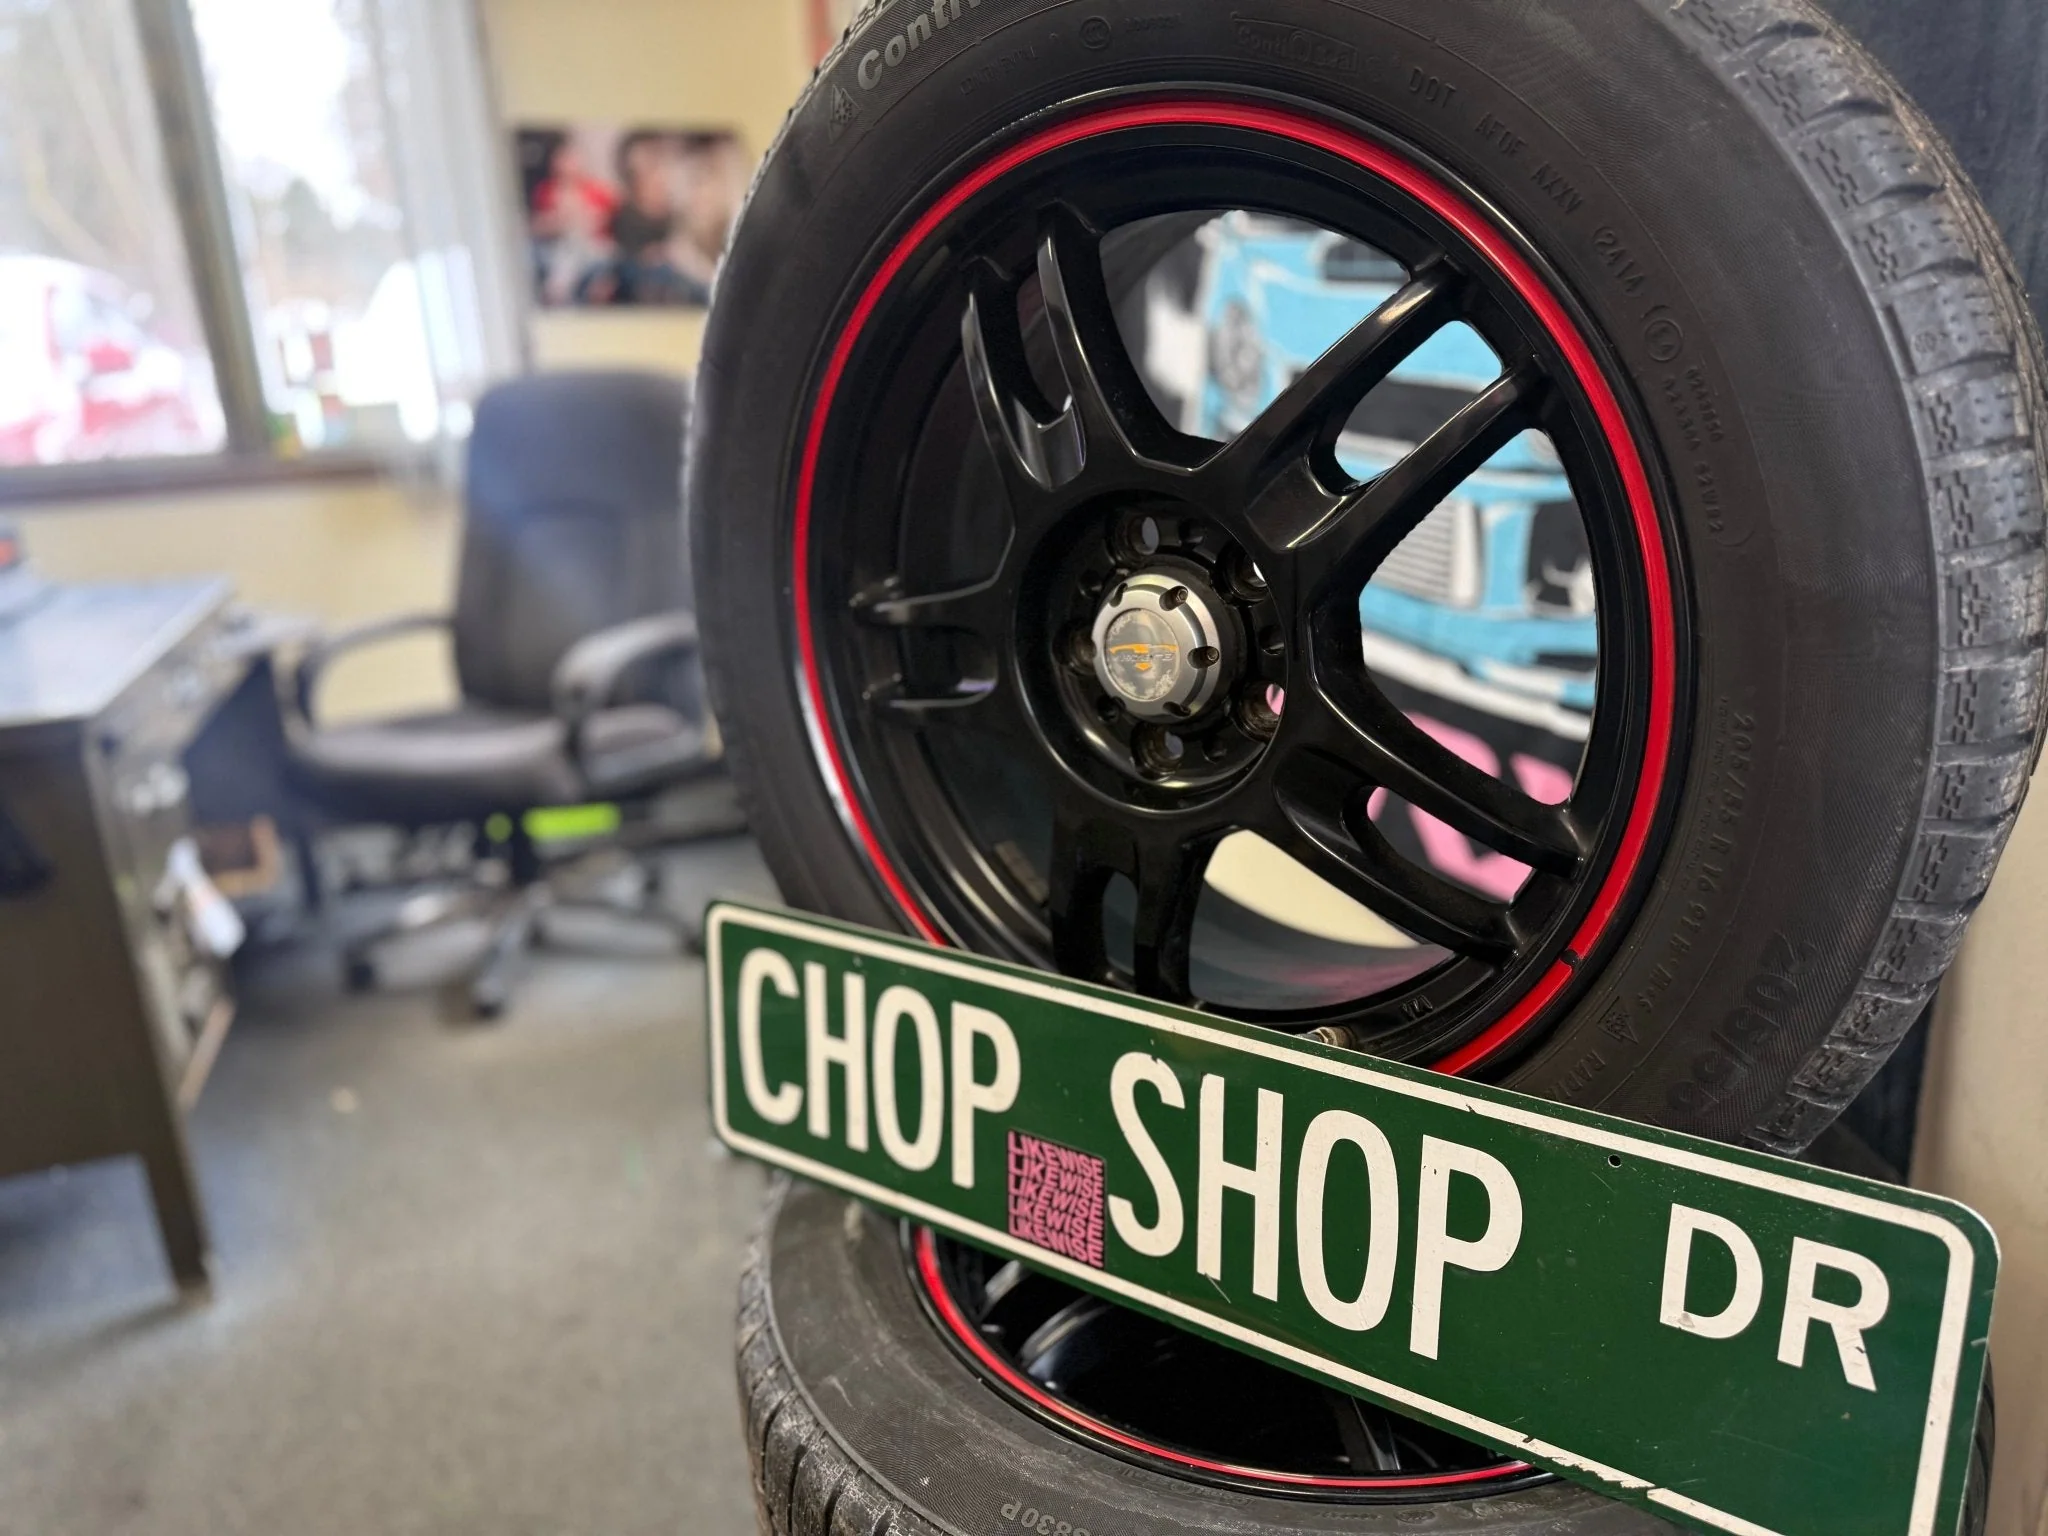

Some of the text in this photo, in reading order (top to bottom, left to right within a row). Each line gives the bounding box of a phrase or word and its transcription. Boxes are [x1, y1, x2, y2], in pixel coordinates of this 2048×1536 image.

[1408, 65, 1456, 108] DOT
[737, 948, 1890, 1392] CHOP SHOP DR
[1008, 1130, 1104, 1181] LIKEWISE
[1008, 1151, 1104, 1203] LIKEWISE
[1008, 1173, 1104, 1224] LIKEWISE
[1008, 1194, 1104, 1245] LIKEWISE
[1008, 1215, 1104, 1267] LIKEWISE
